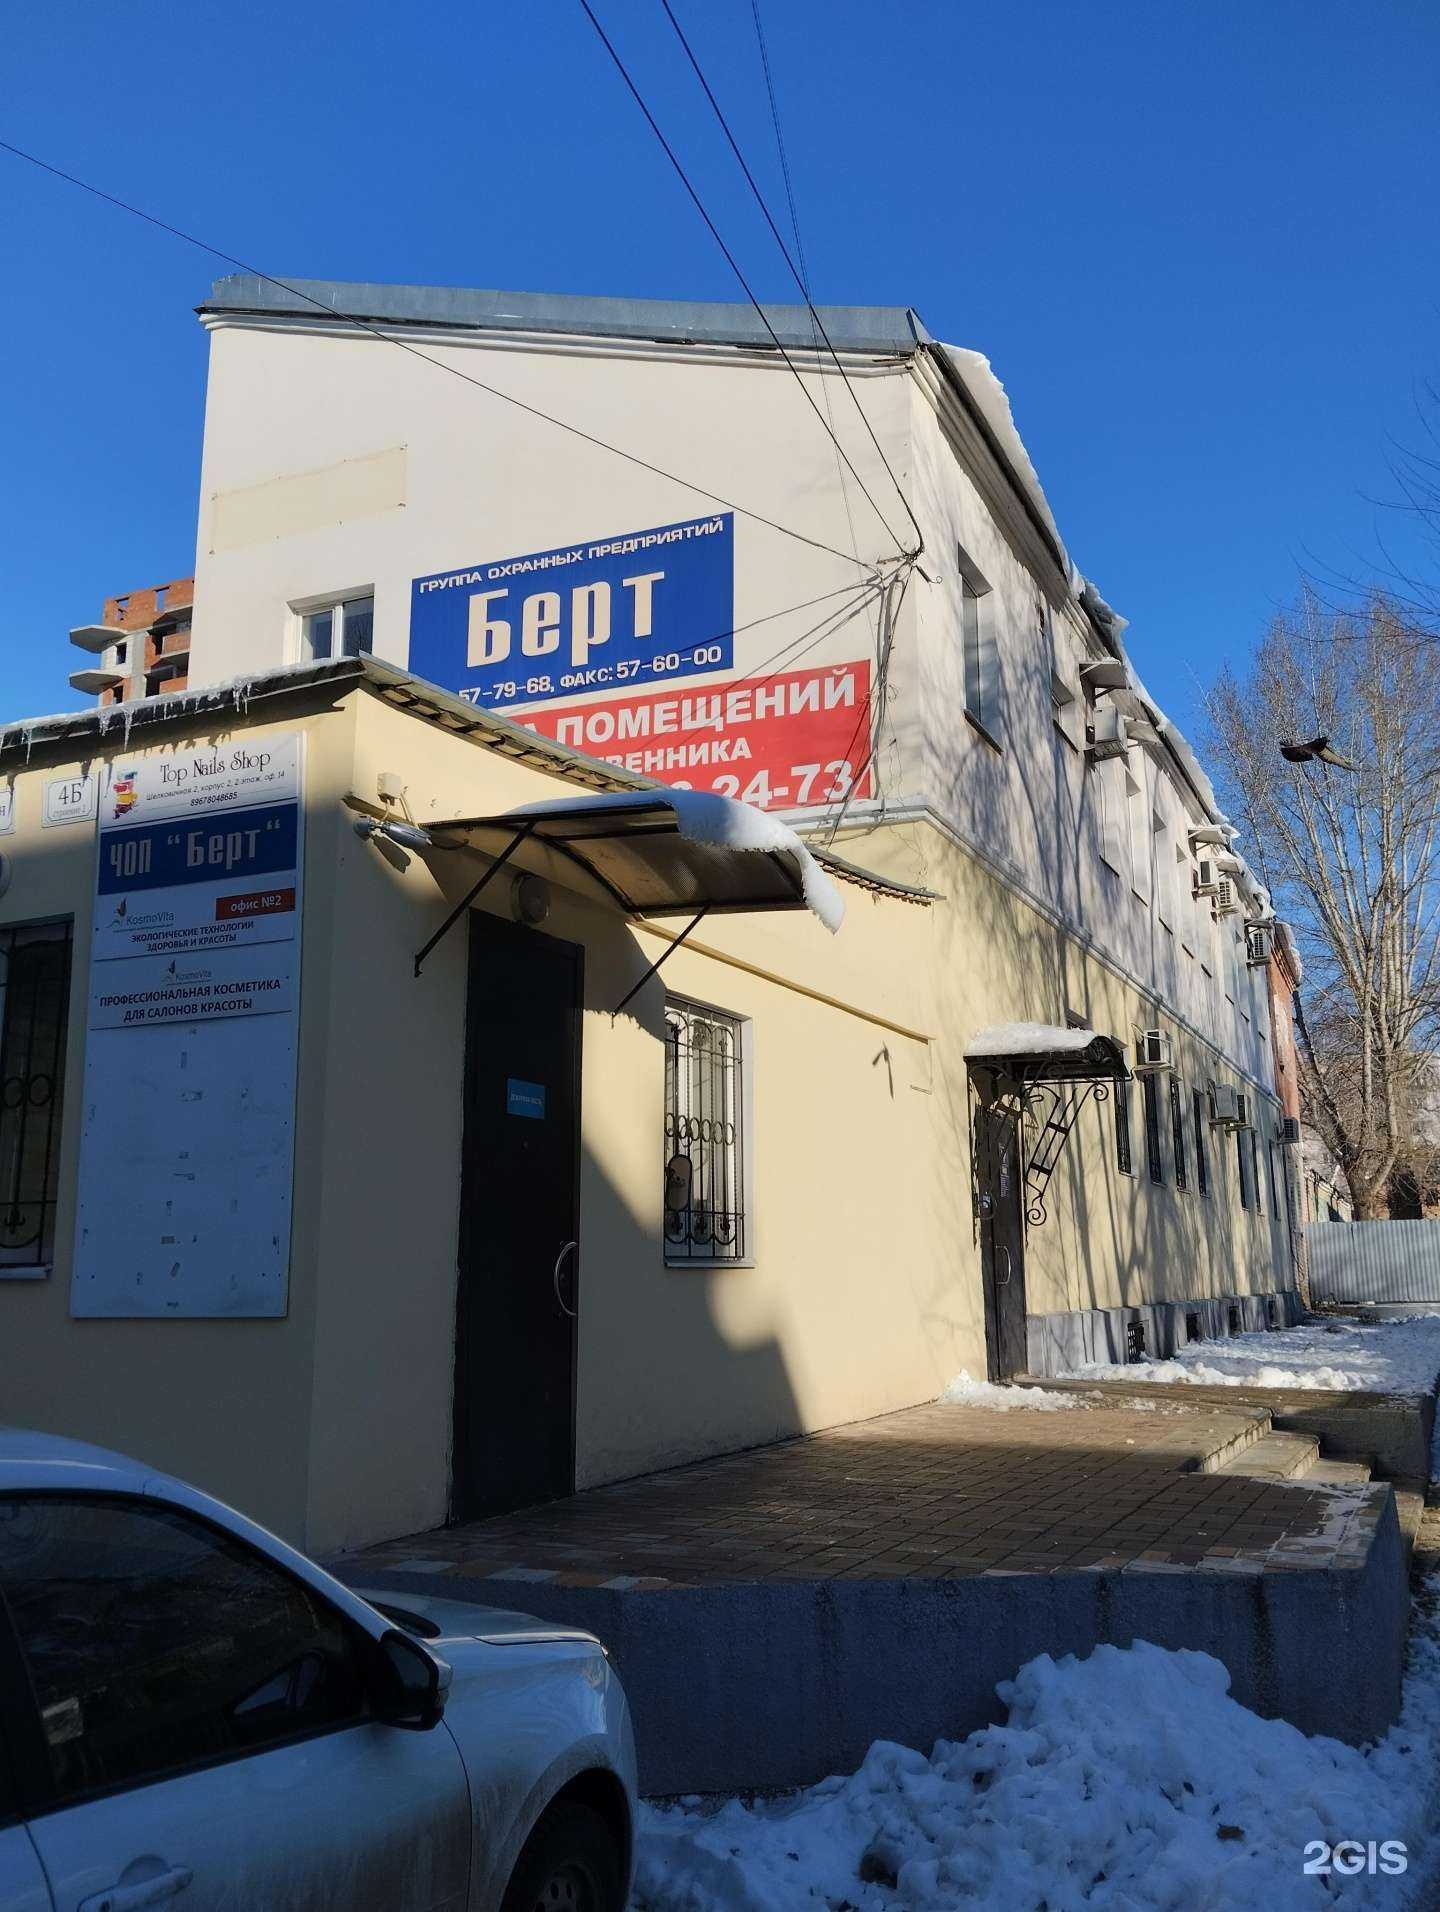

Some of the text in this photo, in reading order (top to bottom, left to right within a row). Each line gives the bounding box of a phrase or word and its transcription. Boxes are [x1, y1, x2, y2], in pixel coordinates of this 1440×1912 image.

[419, 517, 724, 594] ГРУППА ОХРАННЫХ ПРЕДПРИЯТИЙ
[466, 571, 665, 668] Берт
[560, 666, 614, 689] ФАКС:
[616, 645, 722, 679] 57-60-00
[556, 668, 855, 746] ПОМЕЩЕНИЙ
[160, 750, 271, 786] Top Nails Shop
[58, 782, 82, 805] 4Б
[110, 840, 151, 877] ЧОП
[126, 911, 175, 926] KosmoVita
[230, 895, 282, 915] офис №2
[131, 921, 254, 943] ЭКОЛОГИЧЕСКИЕ ТЕХНОЛОГИИ
[147, 934, 237, 952] ЗДОРОВЬЯ И КРАСОТЫ
[99, 979, 281, 1007] ПРОФЕССИОНАЛЬНАЯ КОСМЕТИКА
[123, 998, 252, 1024] ДЛЯ САЛОНОВ КРАСОТЫ
